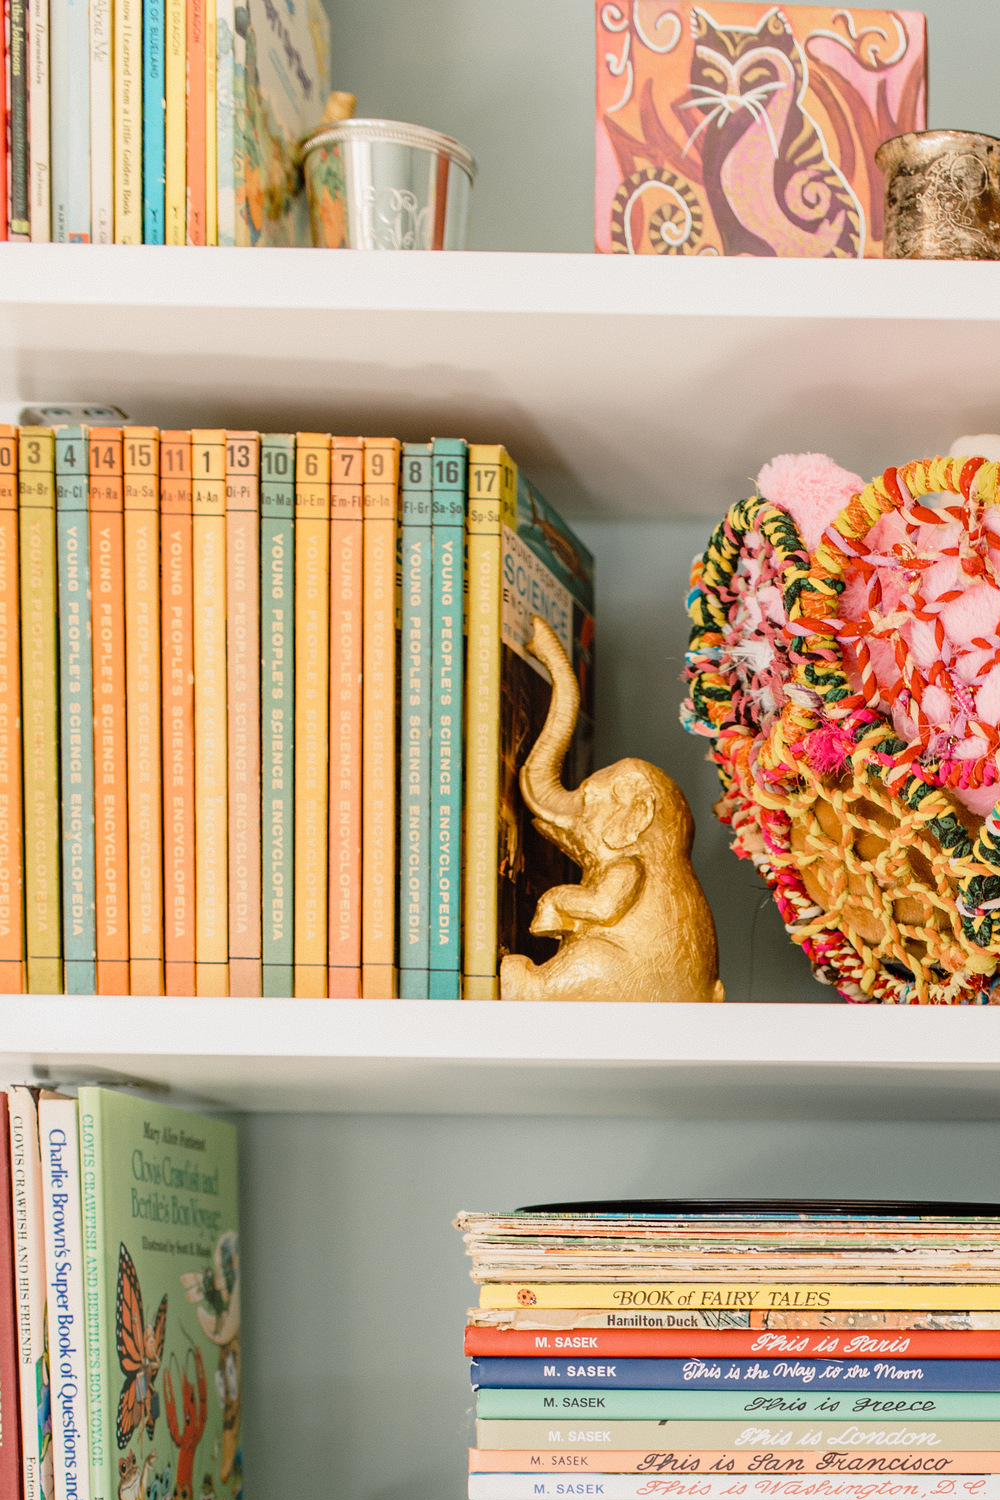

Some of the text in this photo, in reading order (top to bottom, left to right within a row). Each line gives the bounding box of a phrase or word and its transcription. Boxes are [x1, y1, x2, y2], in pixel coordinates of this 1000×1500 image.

[12, 6, 23, 76] the Johnsons
[151, 9, 159, 78] OF BLUELAND
[172, 12, 180, 55] DRAGON
[123, 33, 131, 75] Learned
[123, 79, 131, 104] from
[123, 118, 131, 144] Little
[123, 149, 131, 185] Golden
[123, 190, 131, 216] Book
[28, 442, 41, 462] 3
[64, 445, 76, 467] 4
[92, 447, 114, 468] 14
[128, 445, 150, 465] 15
[166, 449, 183, 471] 11
[228, 446, 250, 467] 13
[265, 452, 287, 474] 10
[409, 460, 422, 483] 8
[437, 460, 458, 482] 16
[475, 470, 496, 492] 17
[99, 528, 116, 936] YOUNG PEOPLE'S SCIENCE ENCYCLOPEDIA
[269, 533, 285, 940] YOUNG PEOPLE'S SCIENCE ENCYCLOPEDIA
[438, 540, 453, 945] YOUNG PEOPLE'S SCIENCE ENCYCLOPEDIA
[13, 1116, 24, 1166] CLOVIS
[49, 1129, 68, 1188] Charlie
[15, 1170, 27, 1240] CRAWFISH
[52, 1193, 70, 1258] Brown's
[18, 1245, 28, 1274] AND
[20, 1278, 30, 1300] HIS
[51, 1262, 73, 1311] Super
[613, 1291, 830, 1306] BOOK of FAIRY TALES
[607, 1314, 663, 1327] Hamilton
[667, 1315, 698, 1327] Duck
[20, 1305, 32, 1364] FRIENDS
[57, 1315, 77, 1359] Book
[535, 1337, 551, 1348] M.
[555, 1337, 599, 1348] SASEK
[751, 1334, 806, 1351] This
[813, 1336, 839, 1351] is
[844, 1336, 911, 1353] Paris
[60, 1363, 76, 1379] of
[57, 1383, 80, 1468] Questions
[637, 1454, 700, 1471] This
[710, 1456, 734, 1471] is
[747, 1453, 805, 1470] San
[816, 1453, 952, 1471] Francisco
